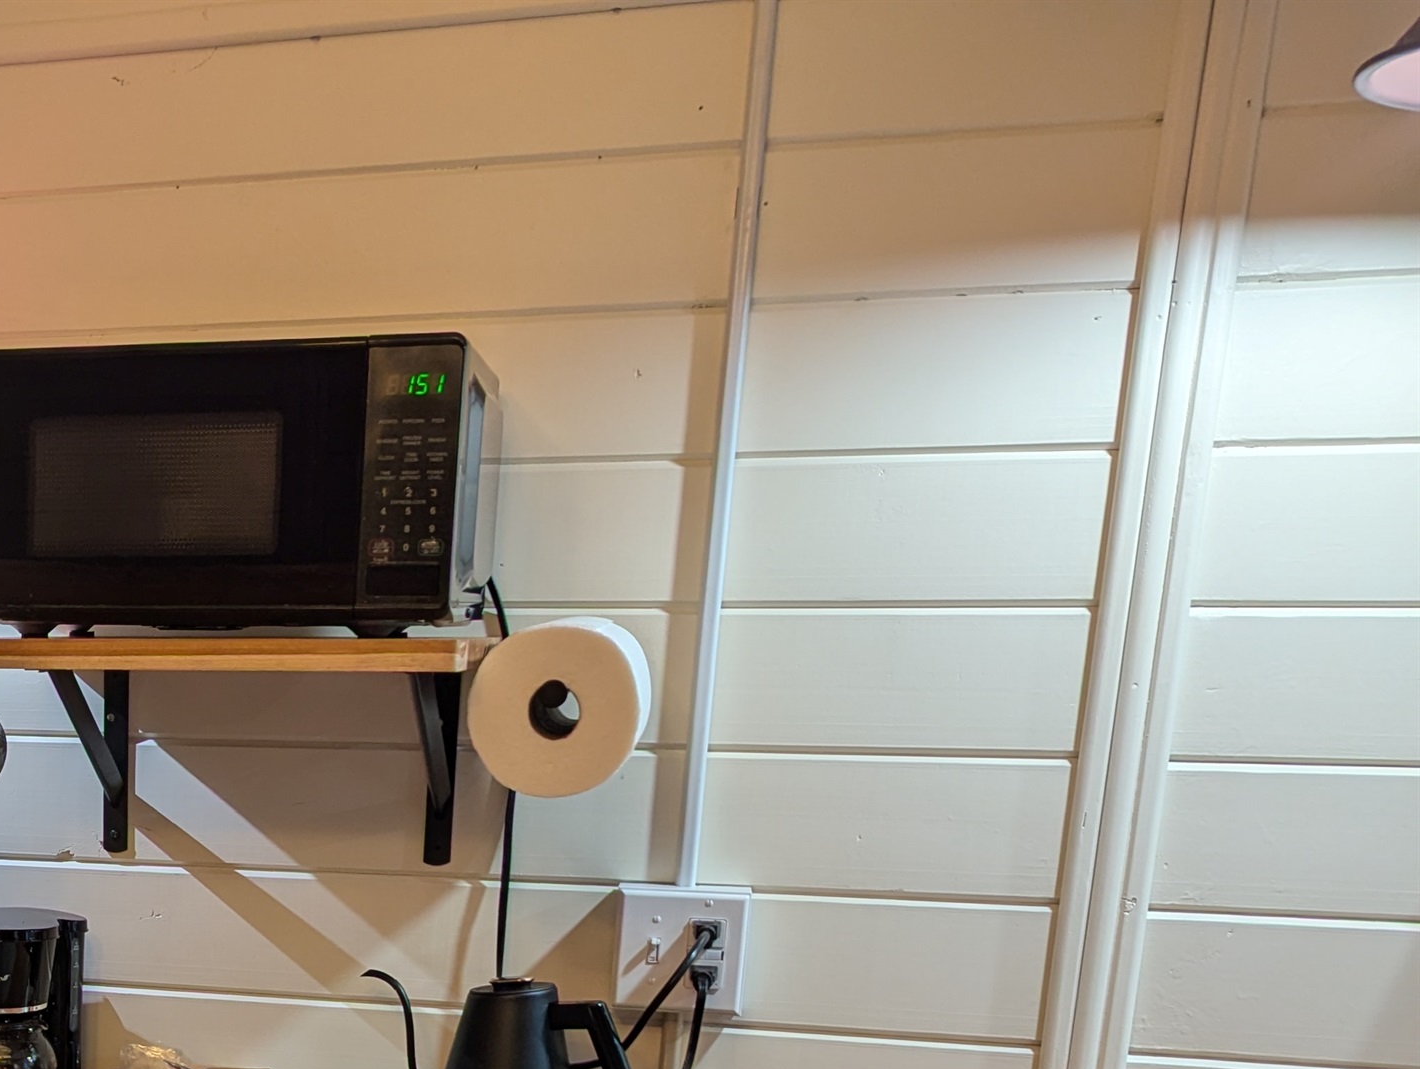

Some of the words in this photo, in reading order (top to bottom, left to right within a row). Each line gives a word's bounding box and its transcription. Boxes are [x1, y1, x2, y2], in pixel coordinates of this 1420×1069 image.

[405, 488, 413, 498] 2
[430, 487, 438, 498] 3
[380, 506, 387, 516] 4
[405, 506, 412, 516] 5
[429, 506, 437, 516] 6
[379, 524, 386, 534] 7
[403, 524, 411, 534] 8
[428, 524, 436, 534] 9
[402, 542, 410, 552] 0
